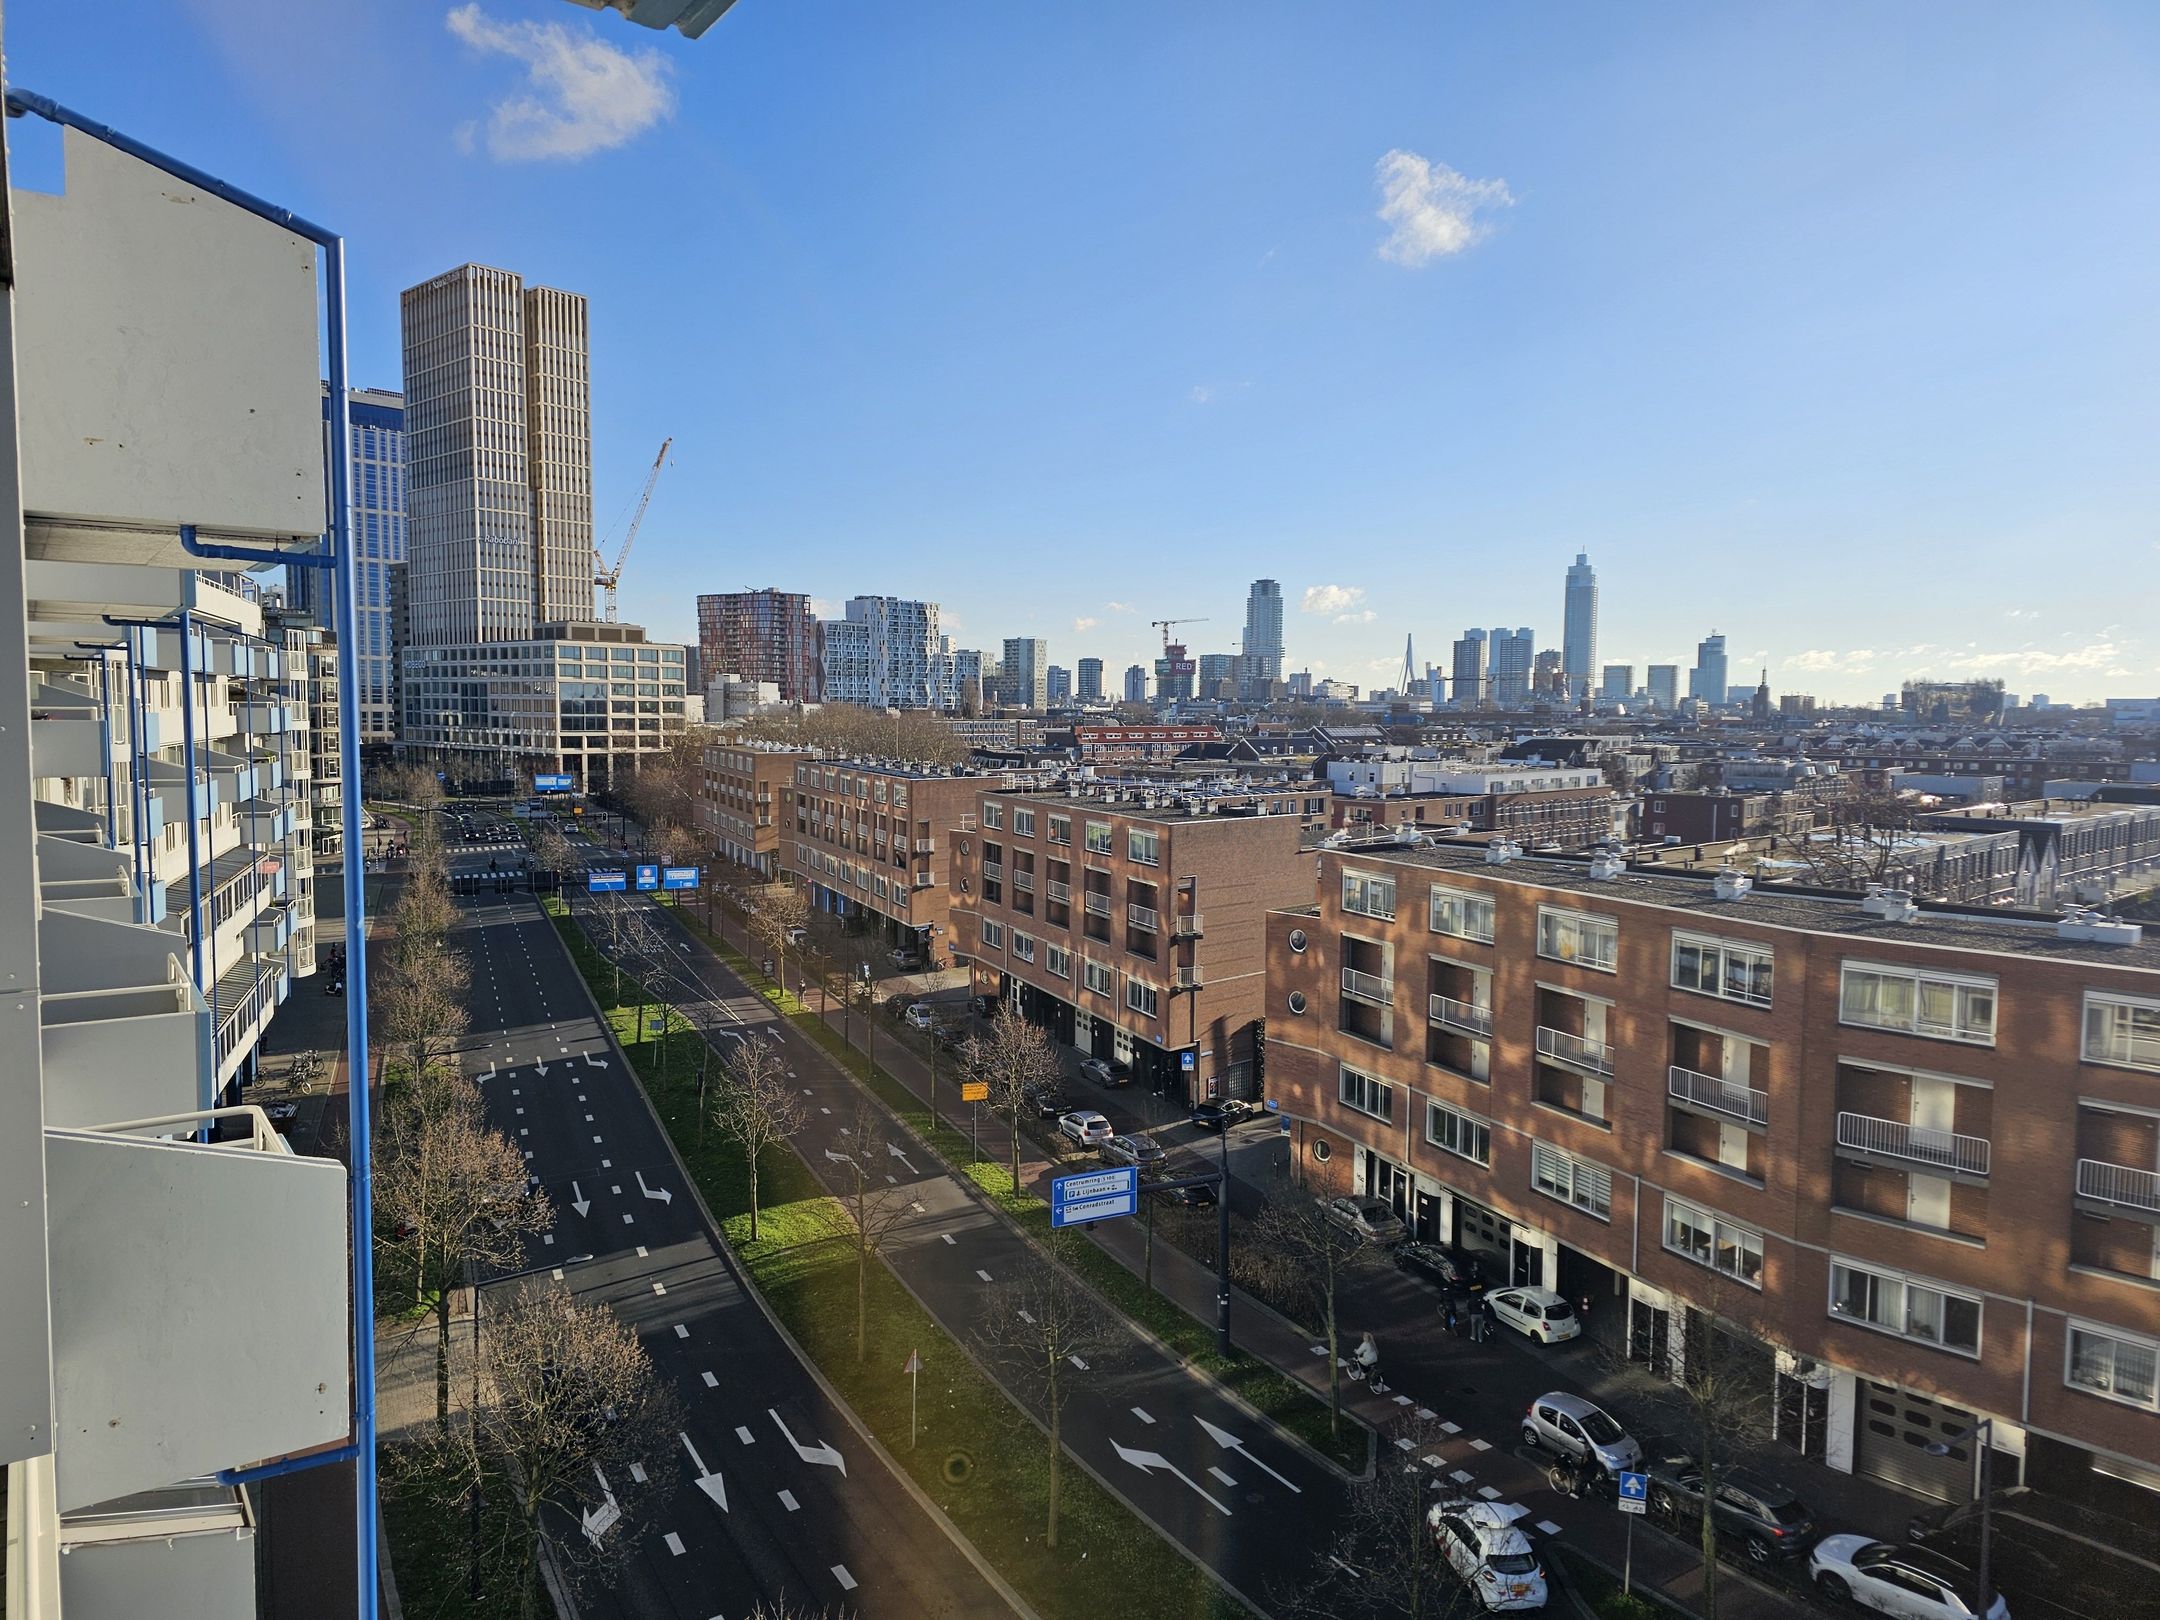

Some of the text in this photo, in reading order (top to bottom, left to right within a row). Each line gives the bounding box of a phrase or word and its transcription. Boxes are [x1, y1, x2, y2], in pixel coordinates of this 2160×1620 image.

[1175, 662, 1192, 670] RED
[1066, 1178, 1100, 1187] Centrumring
[1082, 1186, 1105, 1196] Lijnbaan
[1079, 1199, 1115, 1209] Conradstraat
